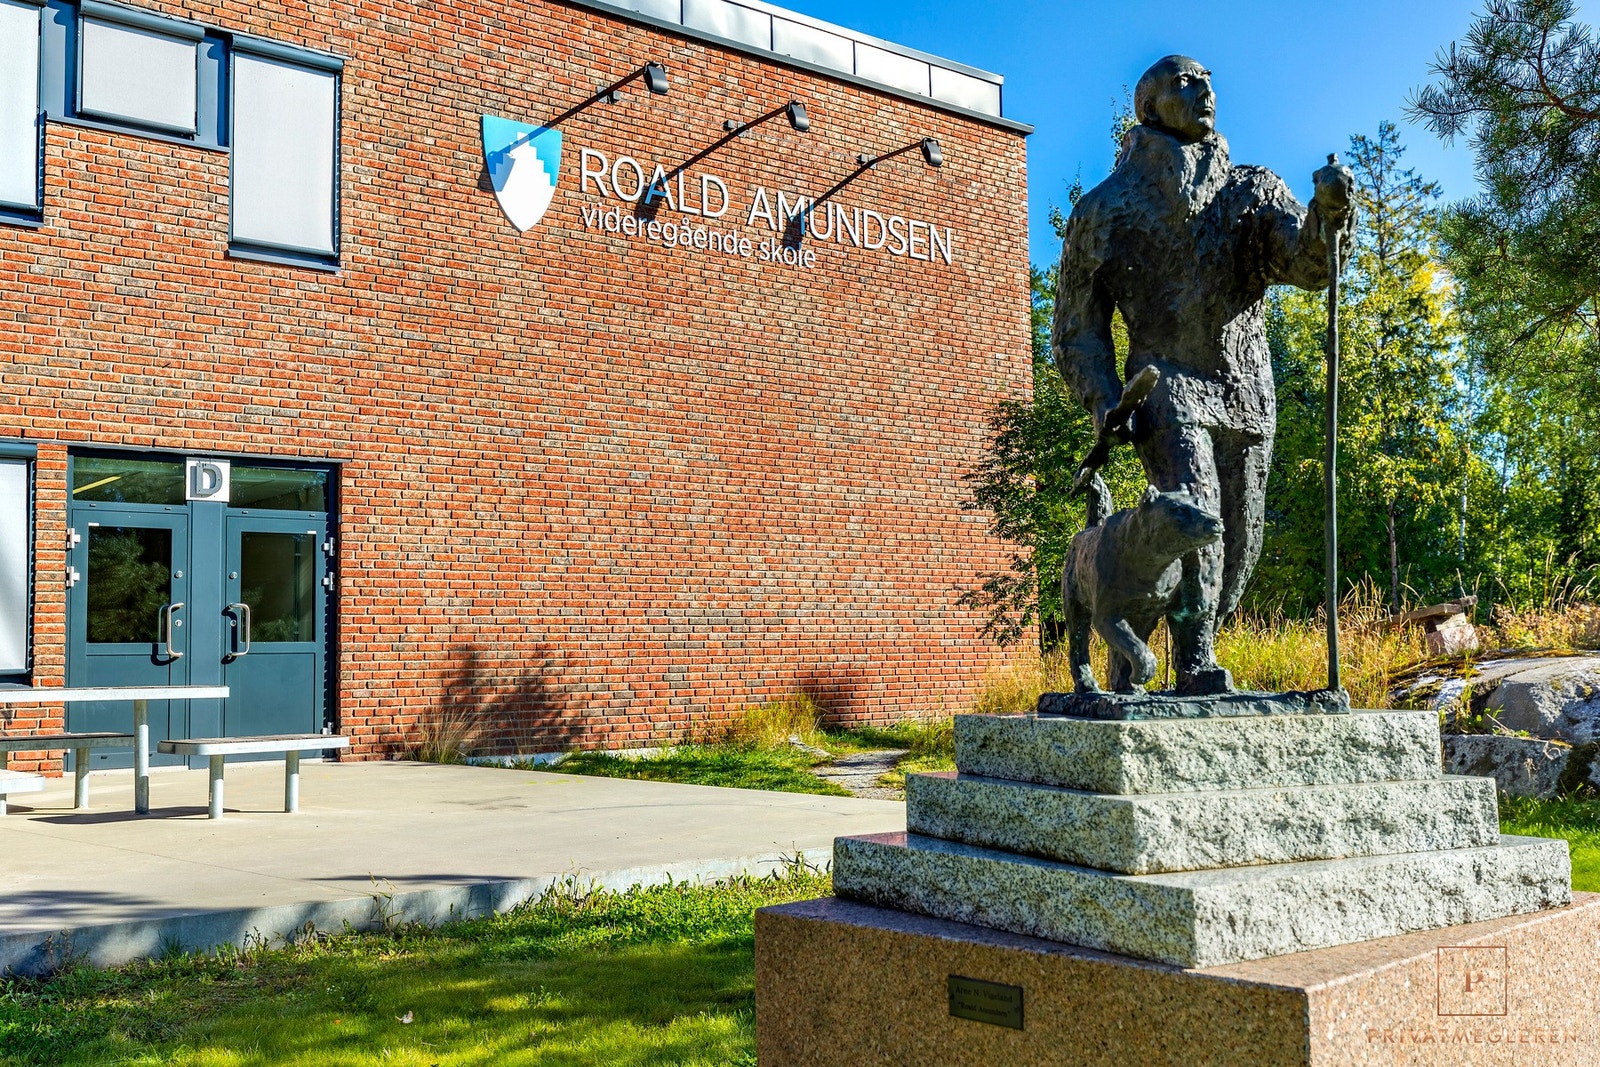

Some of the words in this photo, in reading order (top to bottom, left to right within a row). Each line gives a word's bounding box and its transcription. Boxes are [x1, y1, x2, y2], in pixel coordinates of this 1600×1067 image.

[580, 147, 729, 218] ROALD
[747, 186, 952, 265] AMUNDSEN
[581, 202, 752, 257] videregående
[760, 237, 816, 268] skole
[196, 463, 223, 495] D
